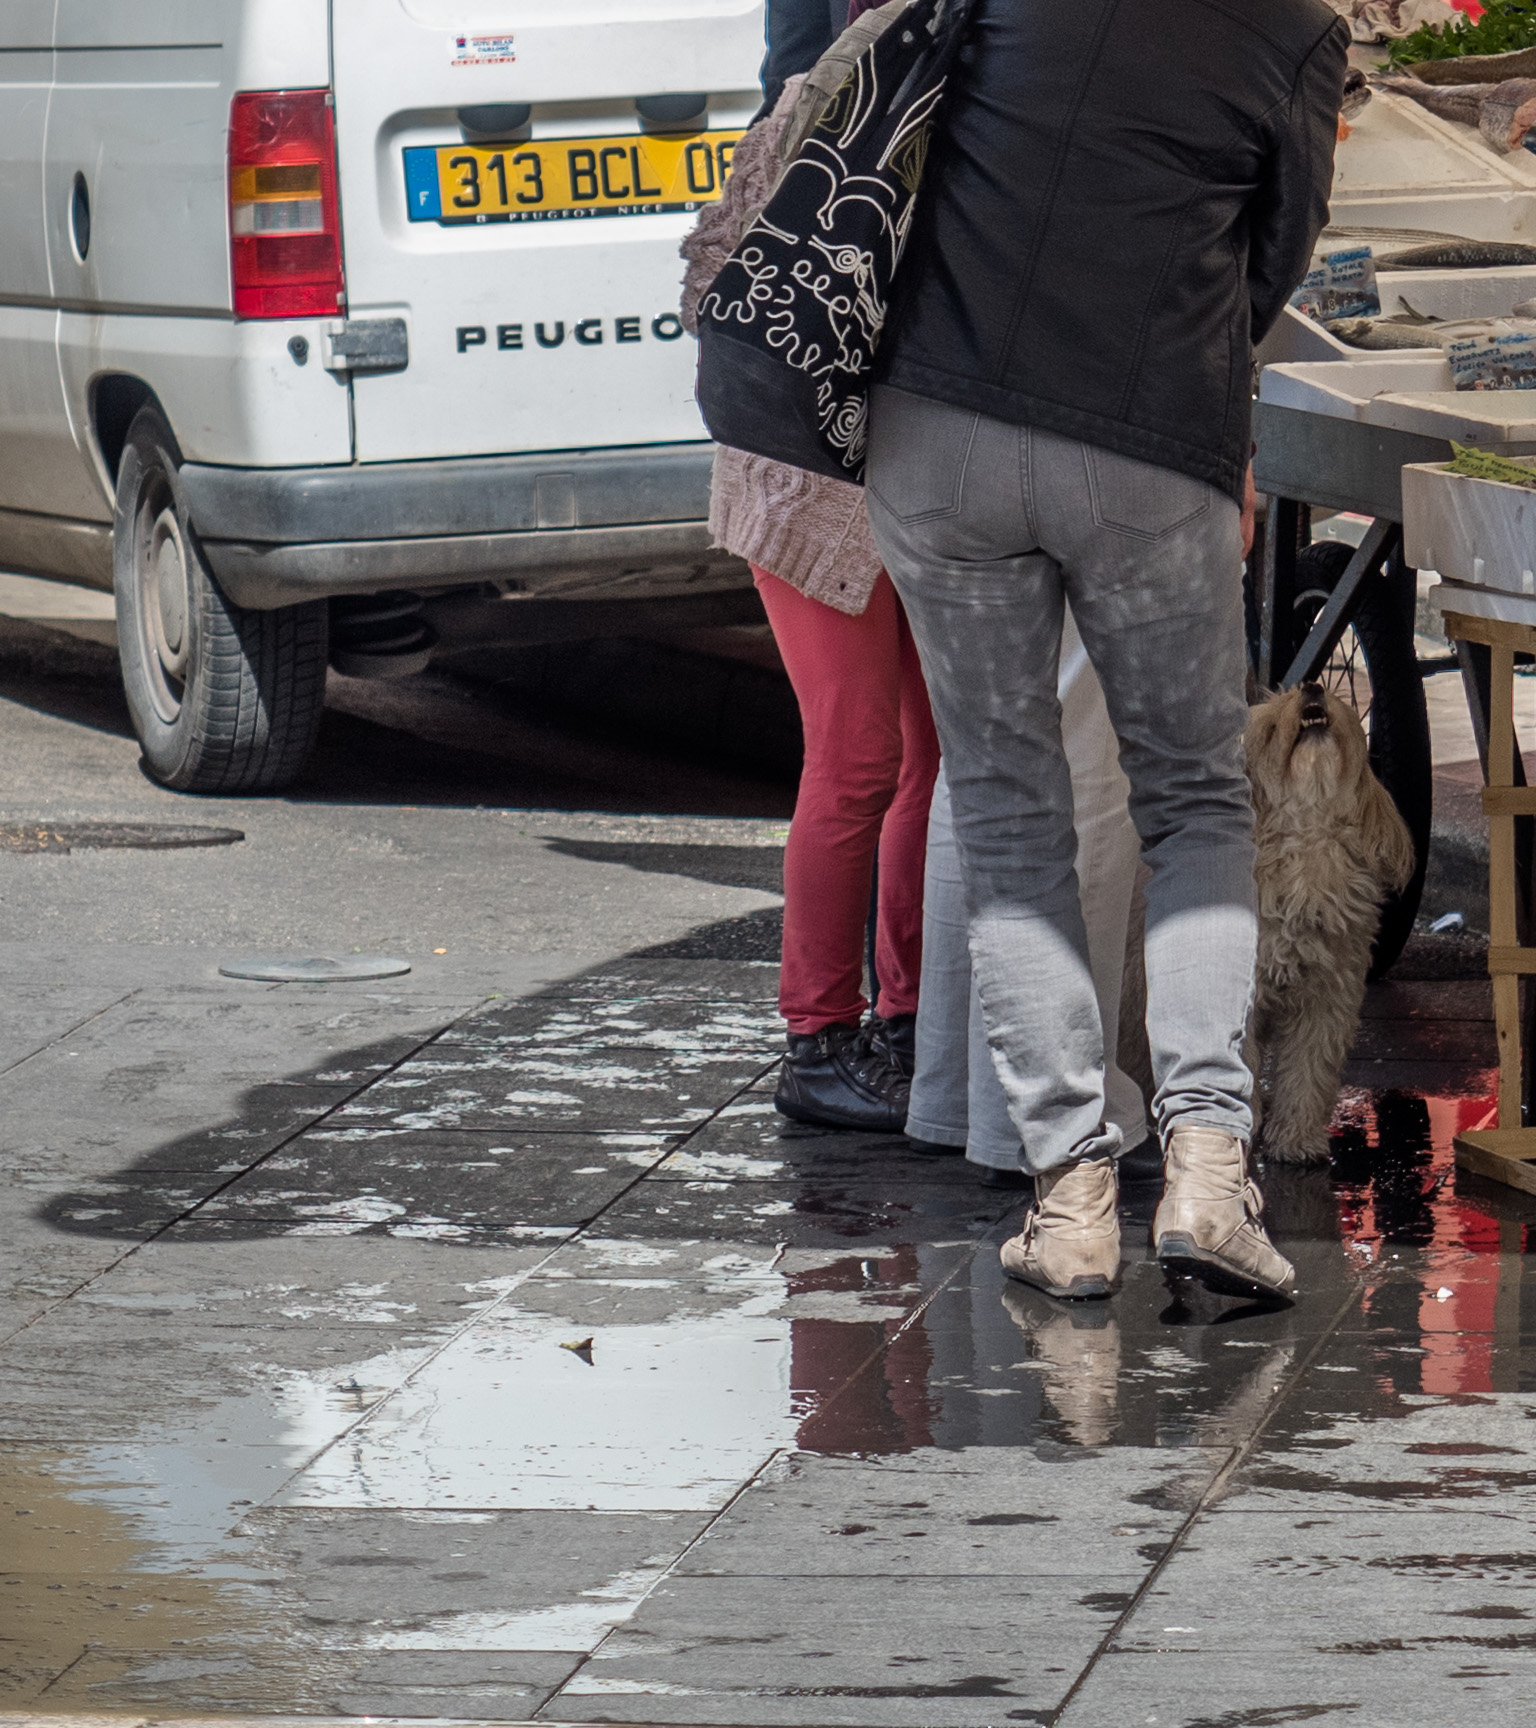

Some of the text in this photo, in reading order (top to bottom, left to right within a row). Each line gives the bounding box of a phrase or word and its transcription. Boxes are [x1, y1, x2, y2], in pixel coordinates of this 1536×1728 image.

[449, 151, 545, 209] 313
[566, 145, 662, 202] BCL
[508, 202, 664, 222] PEUGEOT NICE
[455, 312, 685, 354] PEUGEO
